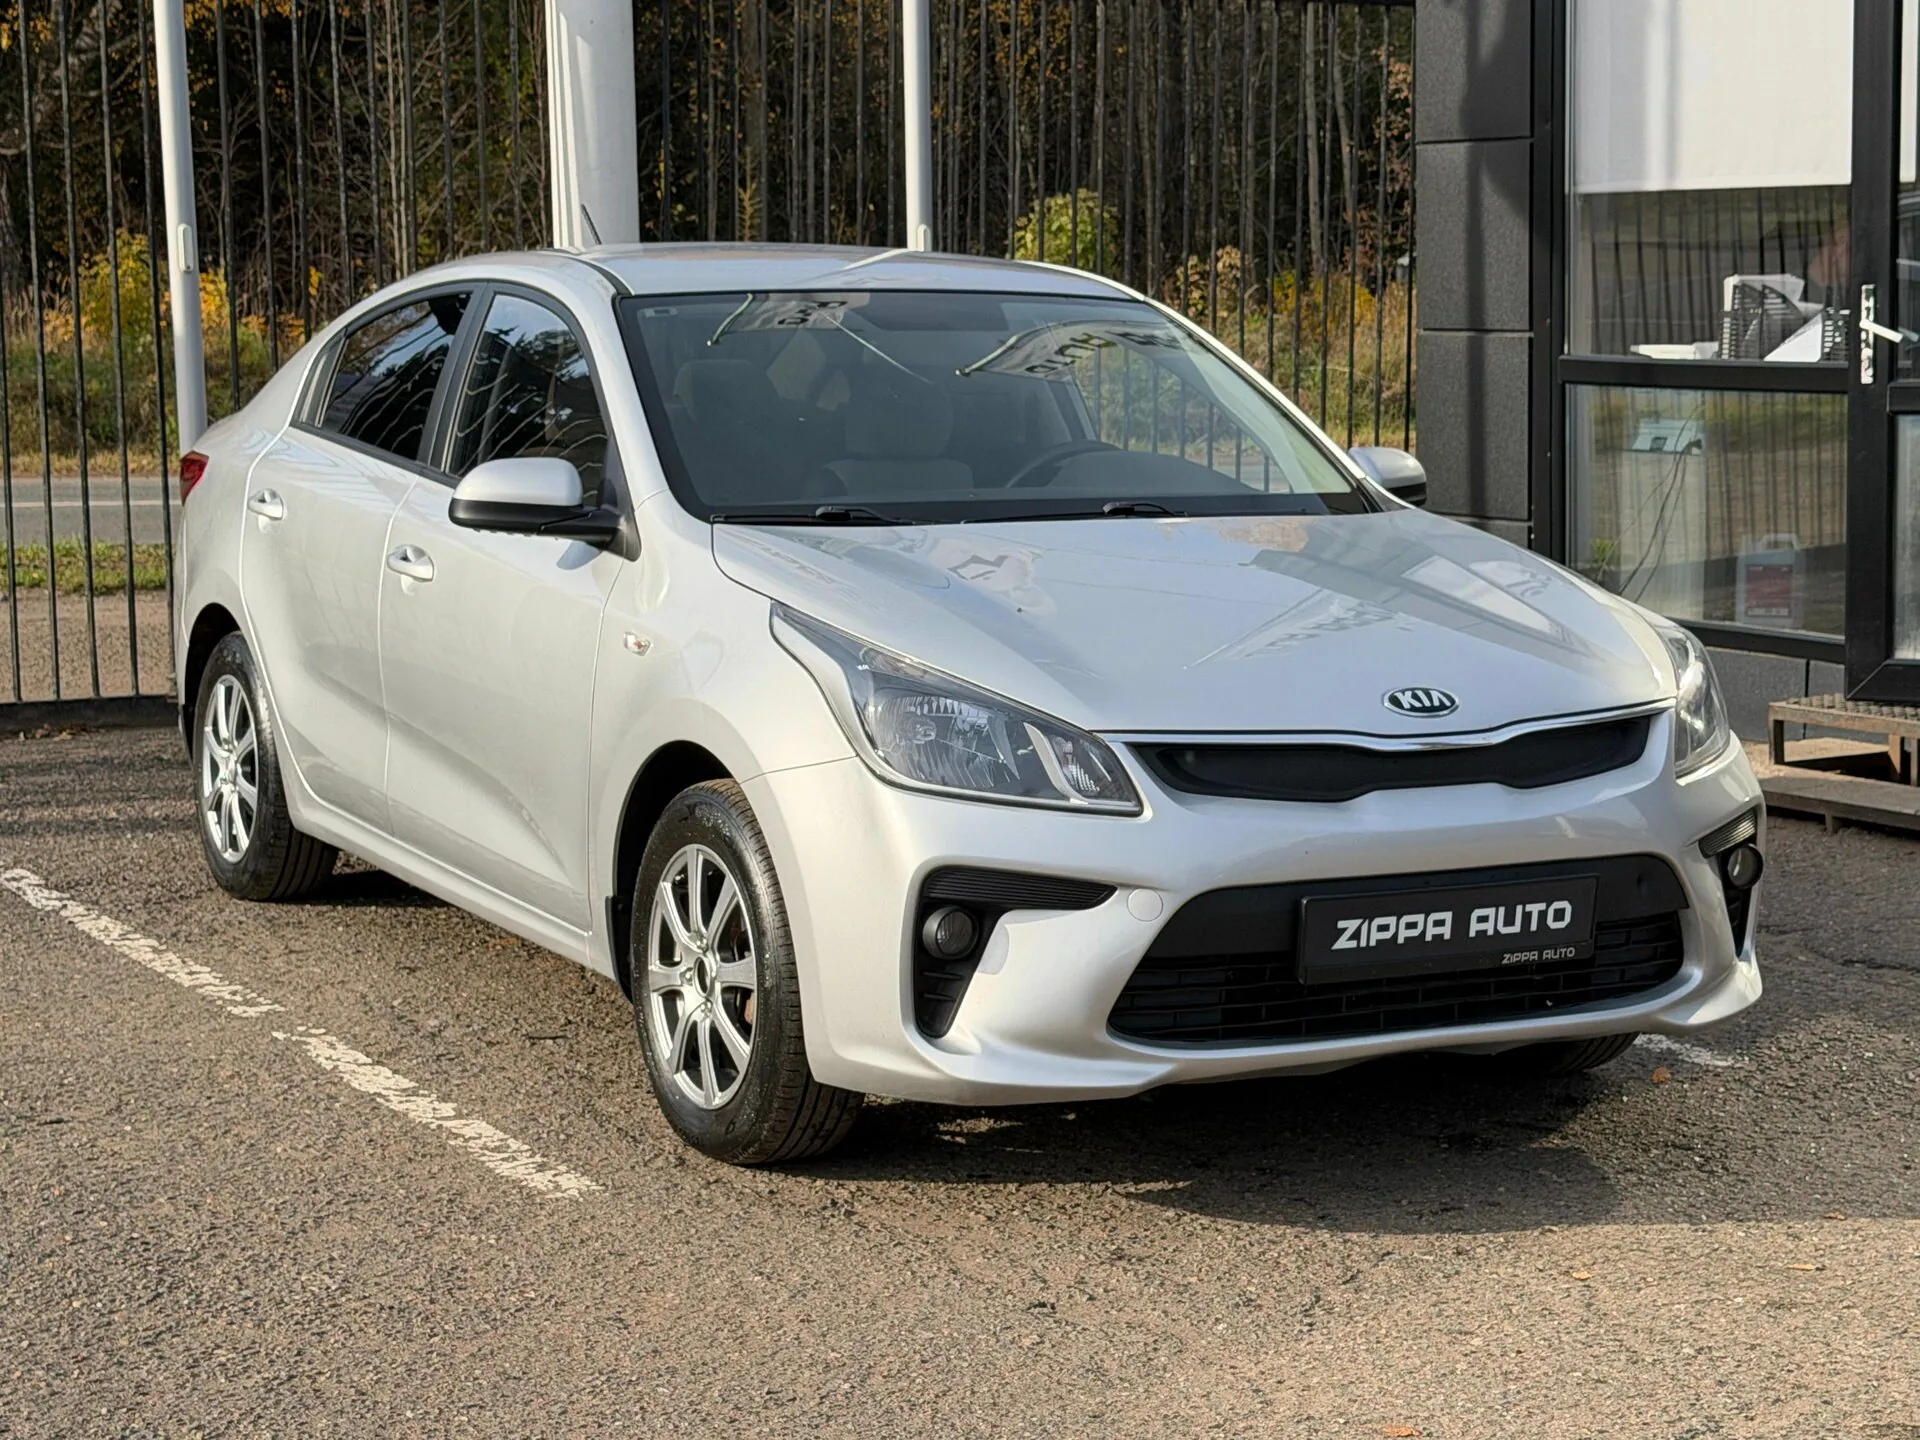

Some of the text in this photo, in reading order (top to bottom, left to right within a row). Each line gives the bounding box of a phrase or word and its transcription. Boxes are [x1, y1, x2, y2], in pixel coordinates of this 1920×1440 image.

[1393, 690, 1452, 709] KIA
[1331, 900, 1573, 950] ZIPPA AUTO
[1501, 947, 1576, 964] ZIPPA AUTO
